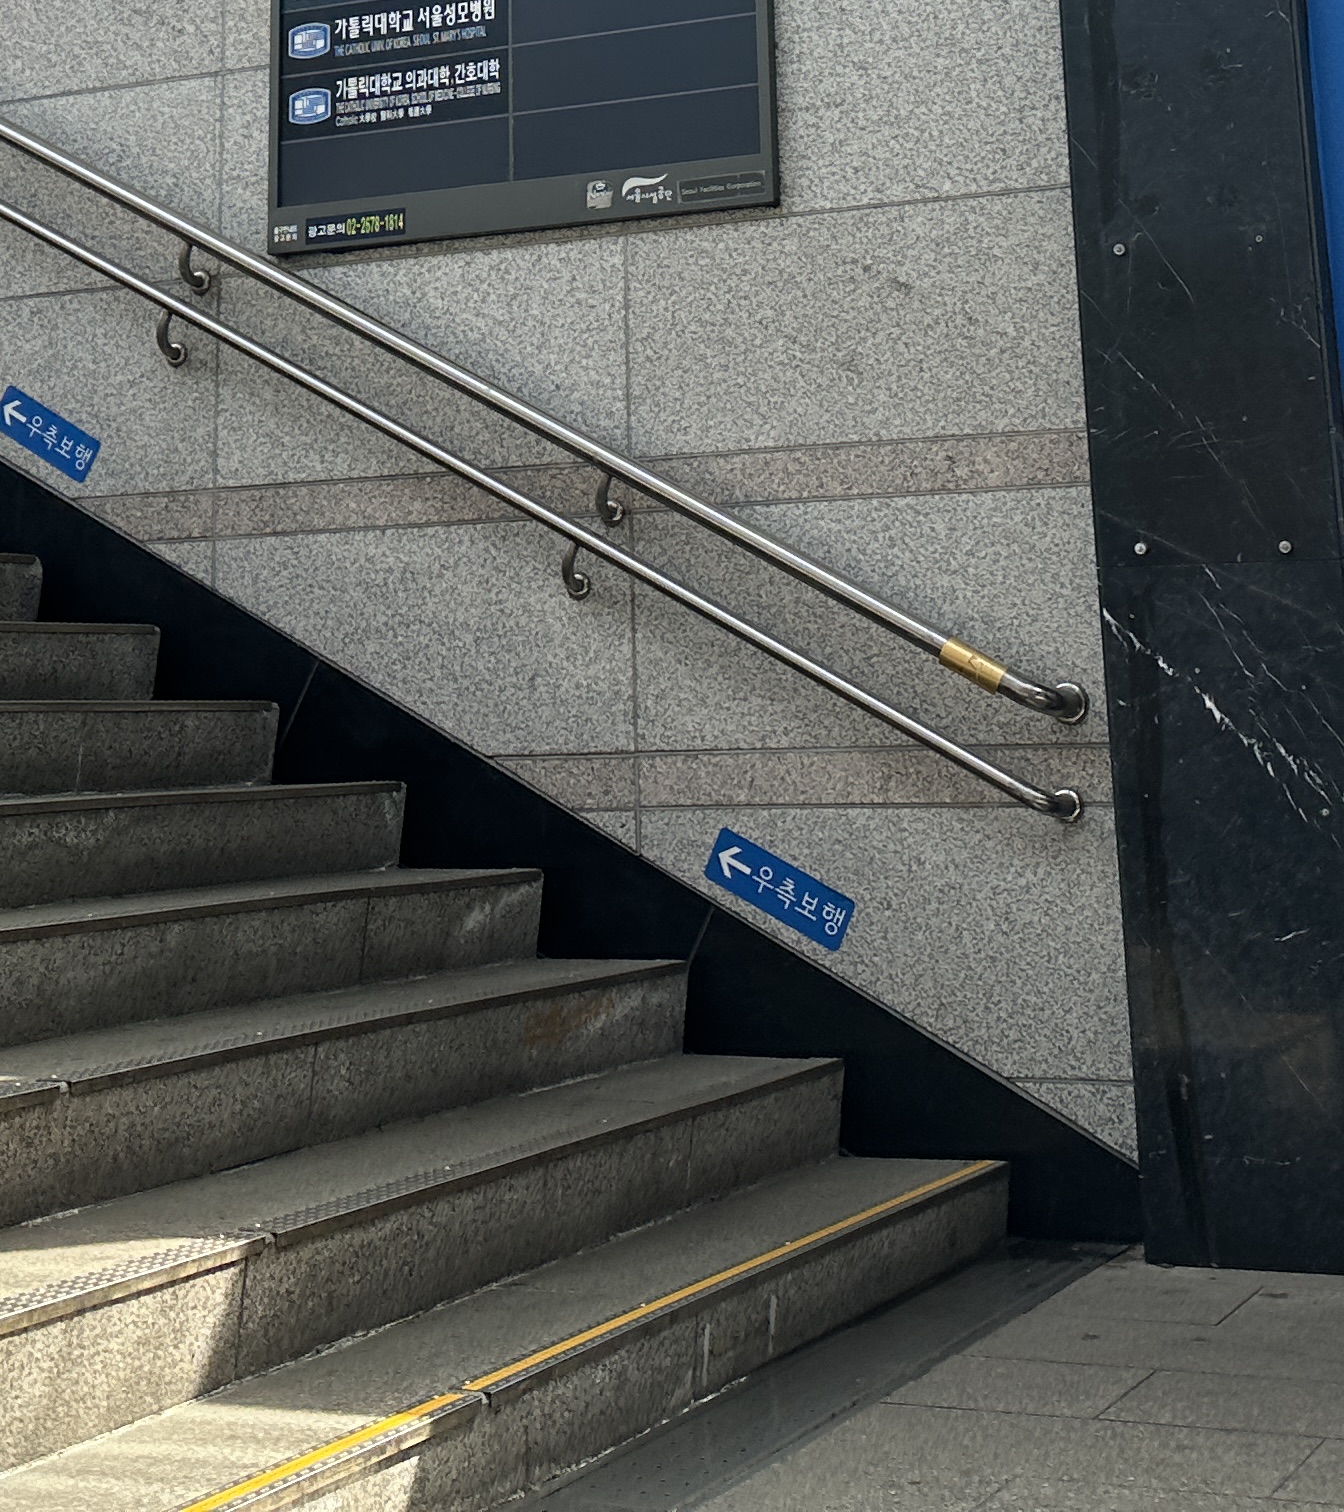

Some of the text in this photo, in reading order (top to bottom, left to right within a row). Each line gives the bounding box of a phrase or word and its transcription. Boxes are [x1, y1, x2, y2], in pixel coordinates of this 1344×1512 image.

[334, 9, 414, 41] 가톨릭대학교
[25, 415, 94, 471] 우측보행
[751, 865, 847, 936] 우측보행
